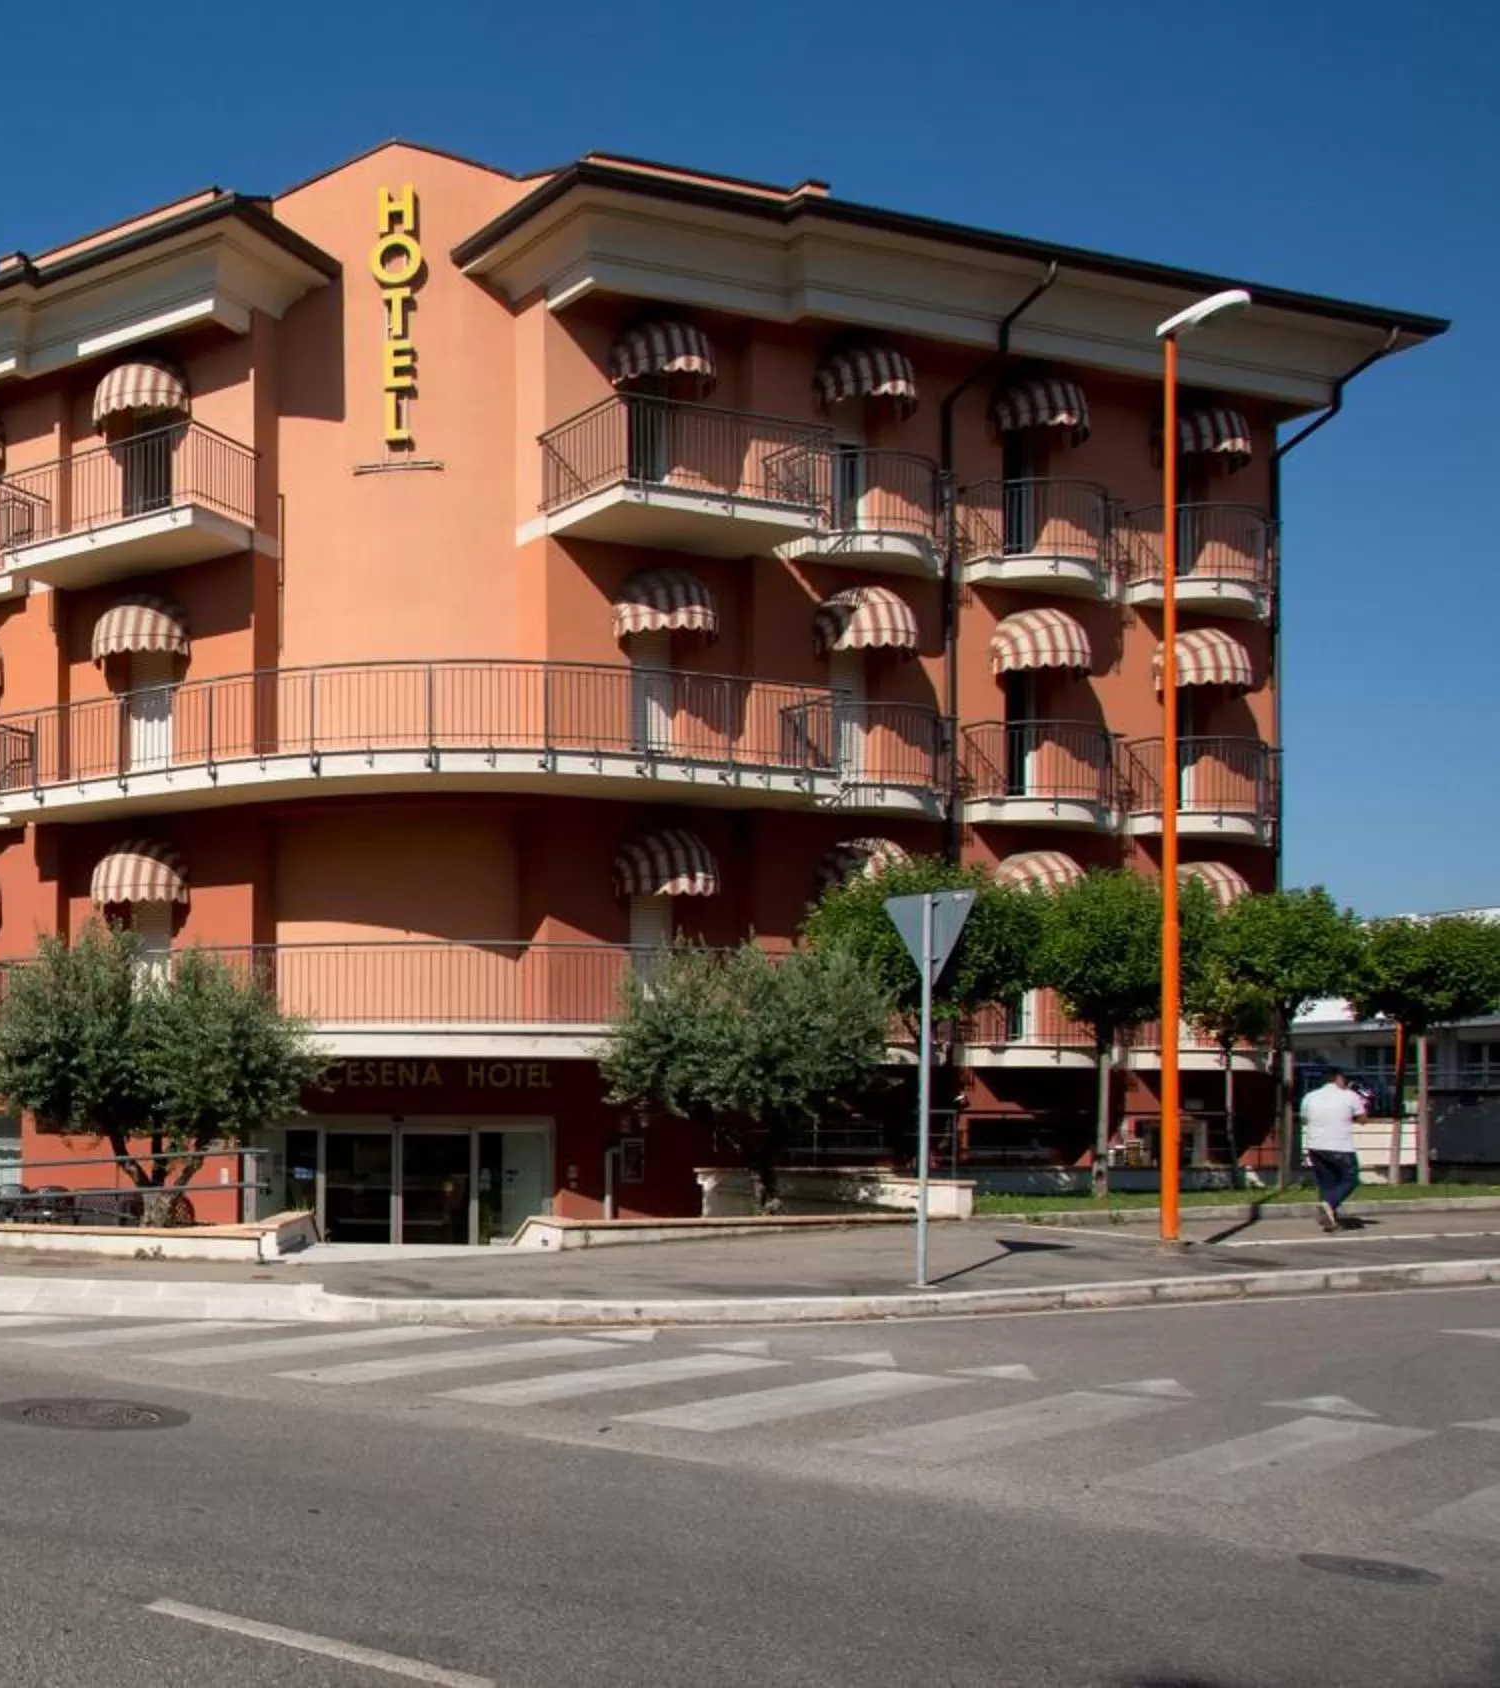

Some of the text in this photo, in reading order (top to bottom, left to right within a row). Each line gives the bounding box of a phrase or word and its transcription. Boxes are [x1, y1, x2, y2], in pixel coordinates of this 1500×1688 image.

[371, 183, 421, 440] HOTEL
[322, 1060, 553, 1088] CESENA HOTEL
